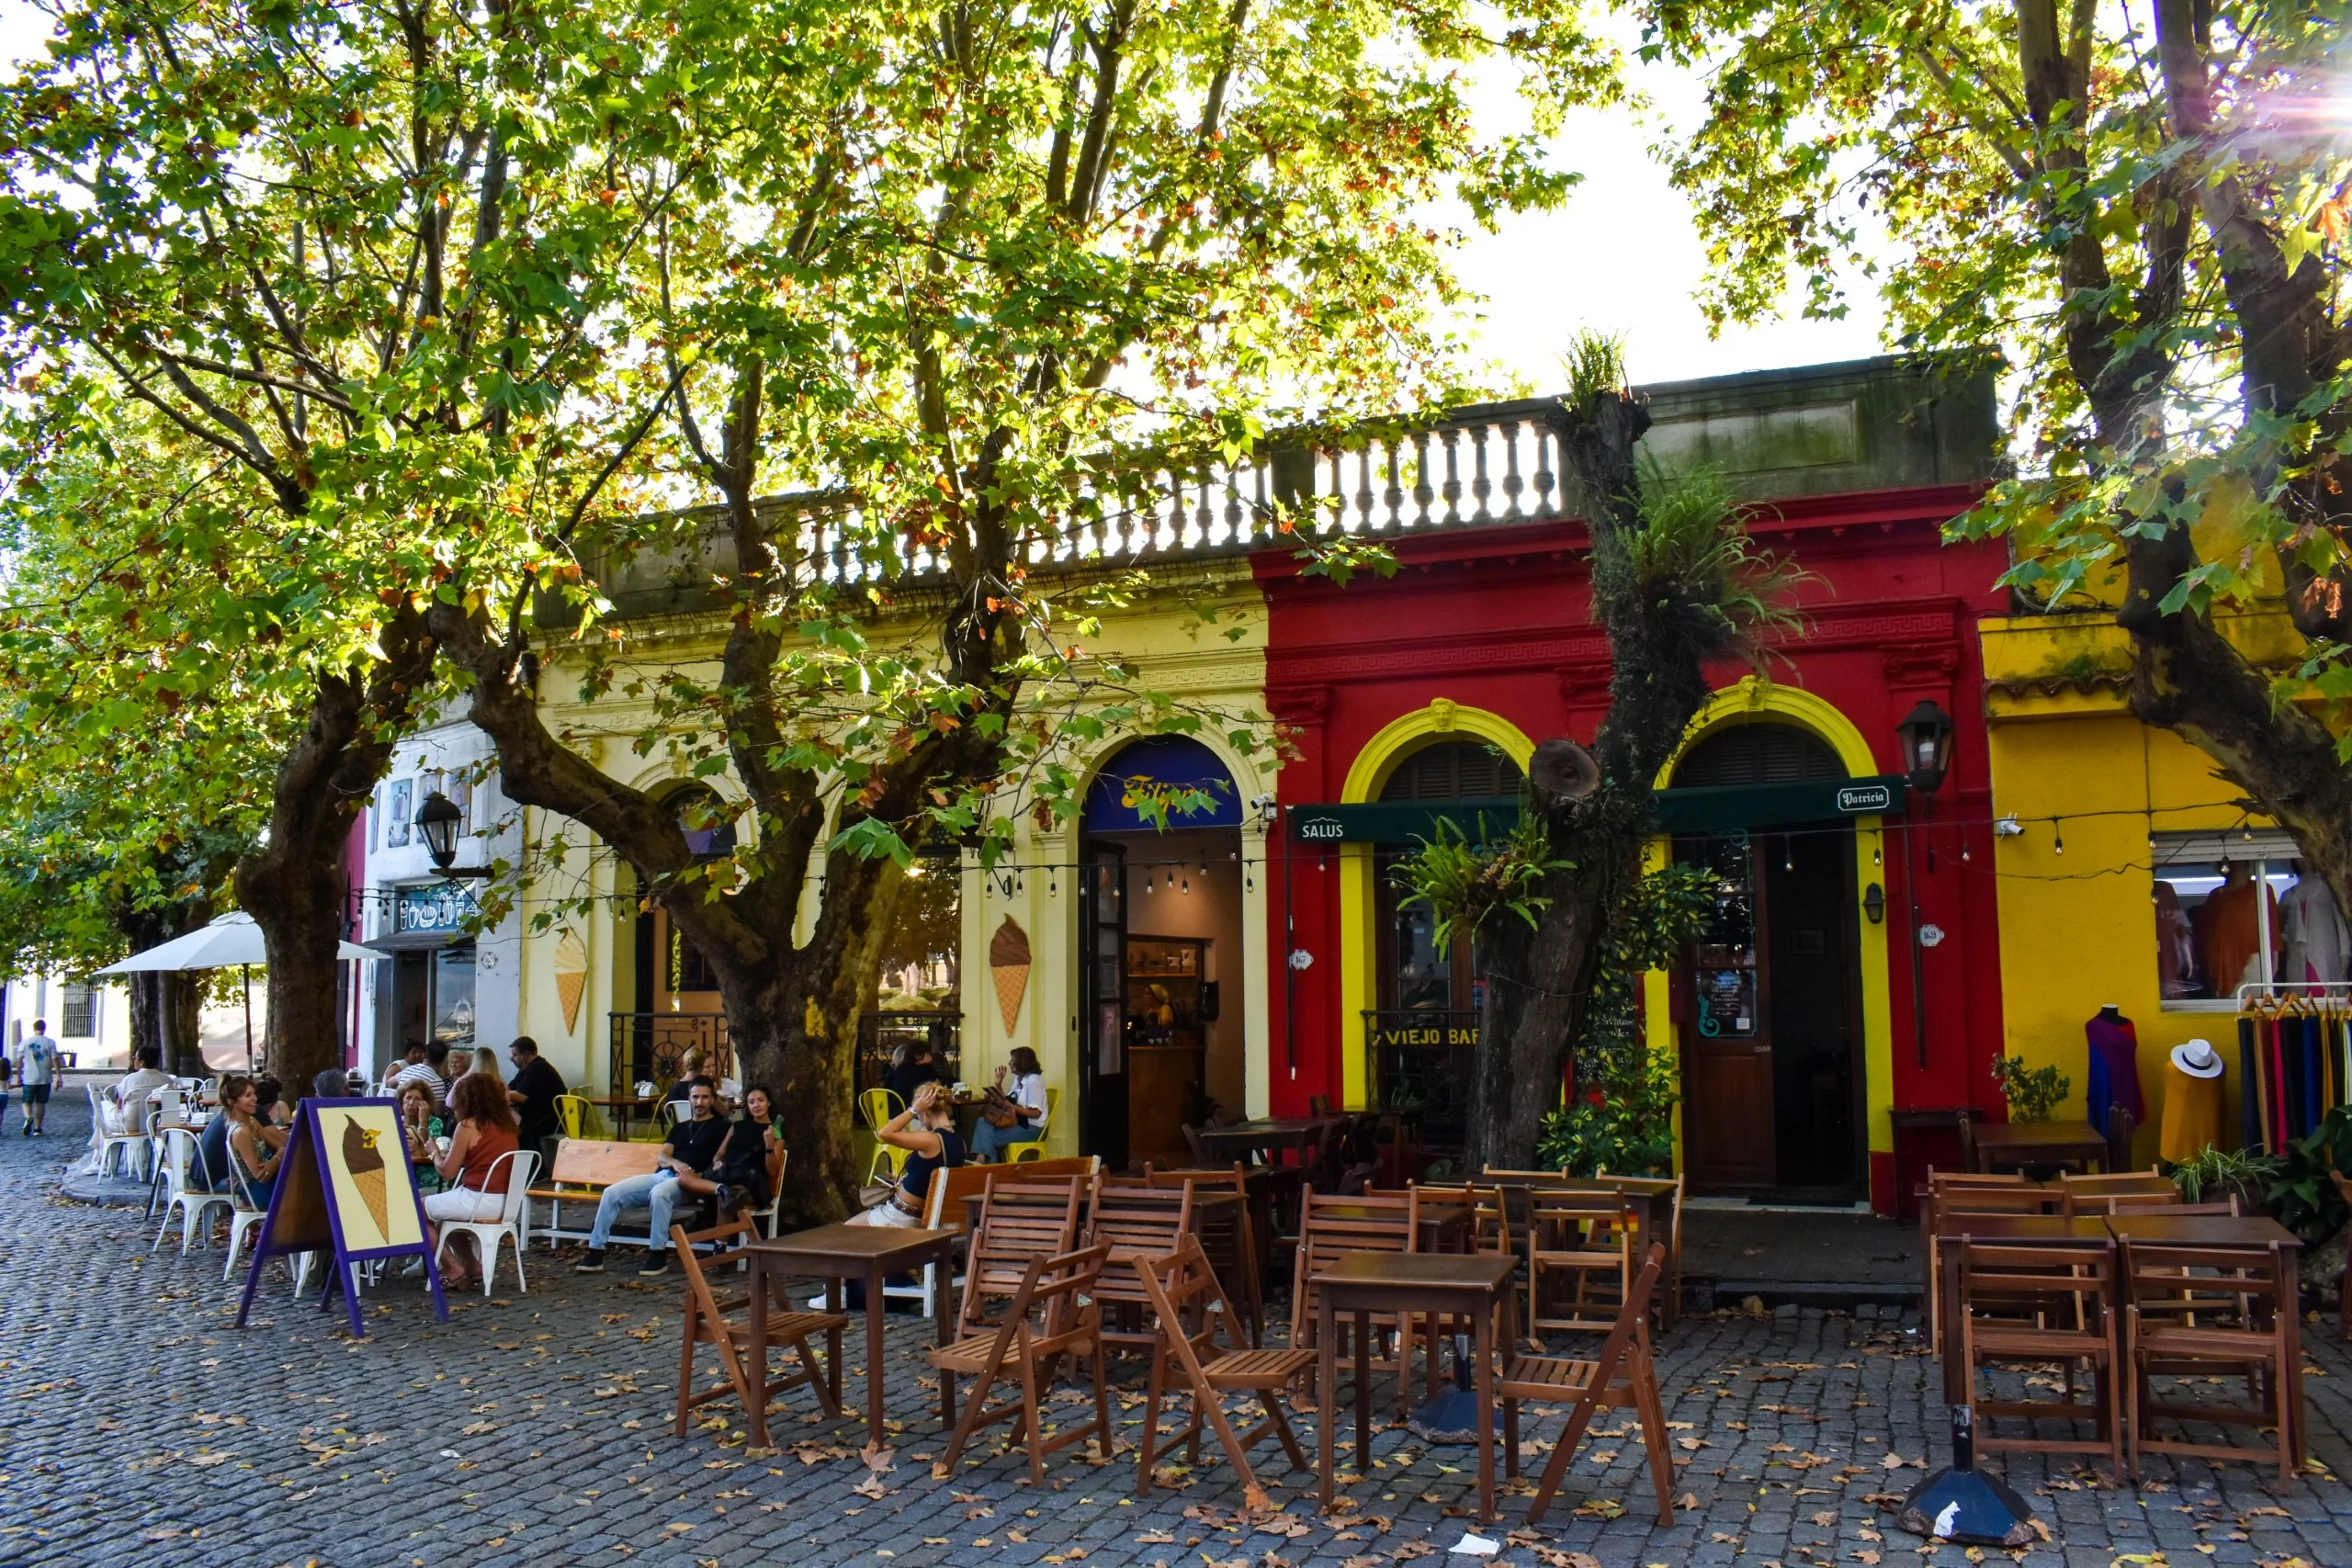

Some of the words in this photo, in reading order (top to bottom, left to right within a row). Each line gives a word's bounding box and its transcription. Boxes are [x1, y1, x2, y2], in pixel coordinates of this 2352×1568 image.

[1842, 792, 1883, 807] Patricia
[1302, 824, 1343, 838] SALUS
[1385, 1029, 1440, 1045] VIEJO
